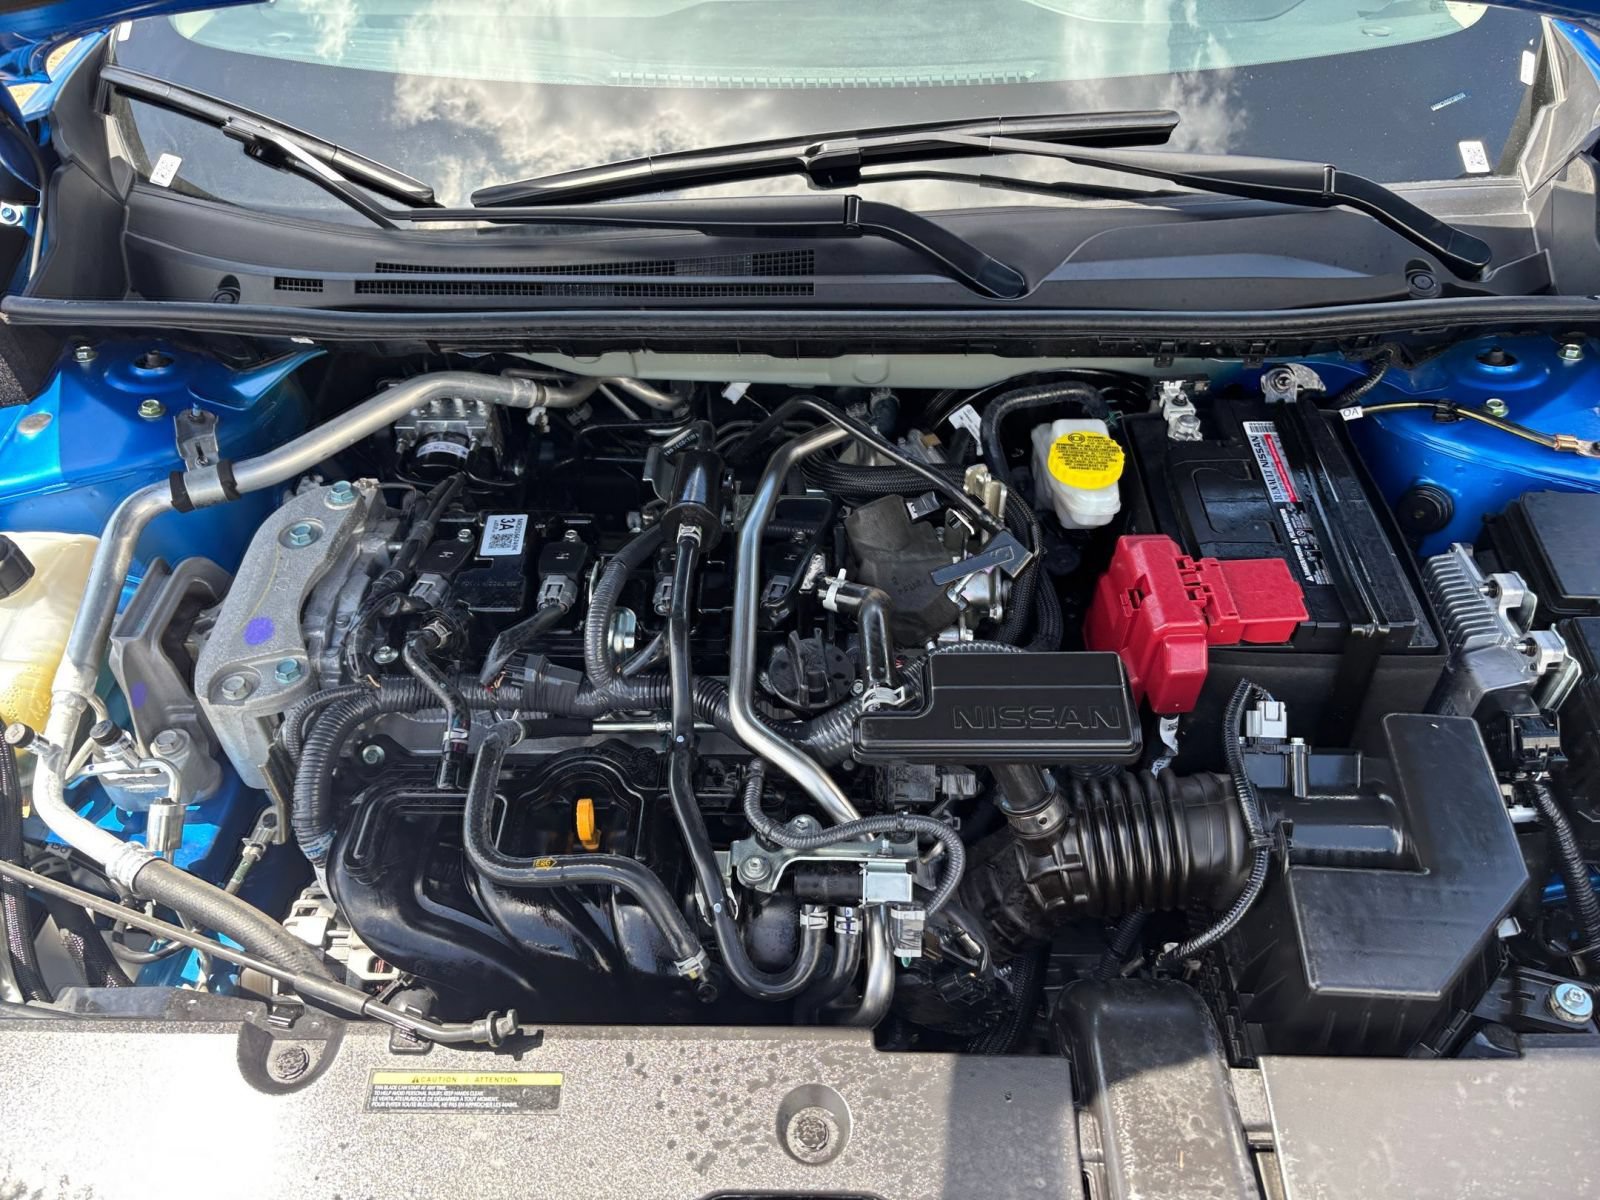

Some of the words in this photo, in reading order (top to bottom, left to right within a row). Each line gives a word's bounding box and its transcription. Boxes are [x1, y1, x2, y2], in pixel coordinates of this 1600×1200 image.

[1250, 436, 1270, 468] NISSAN
[1264, 468, 1283, 500] RENAULT
[498, 518, 516, 531] 3A
[952, 704, 1121, 730] NISSAN
